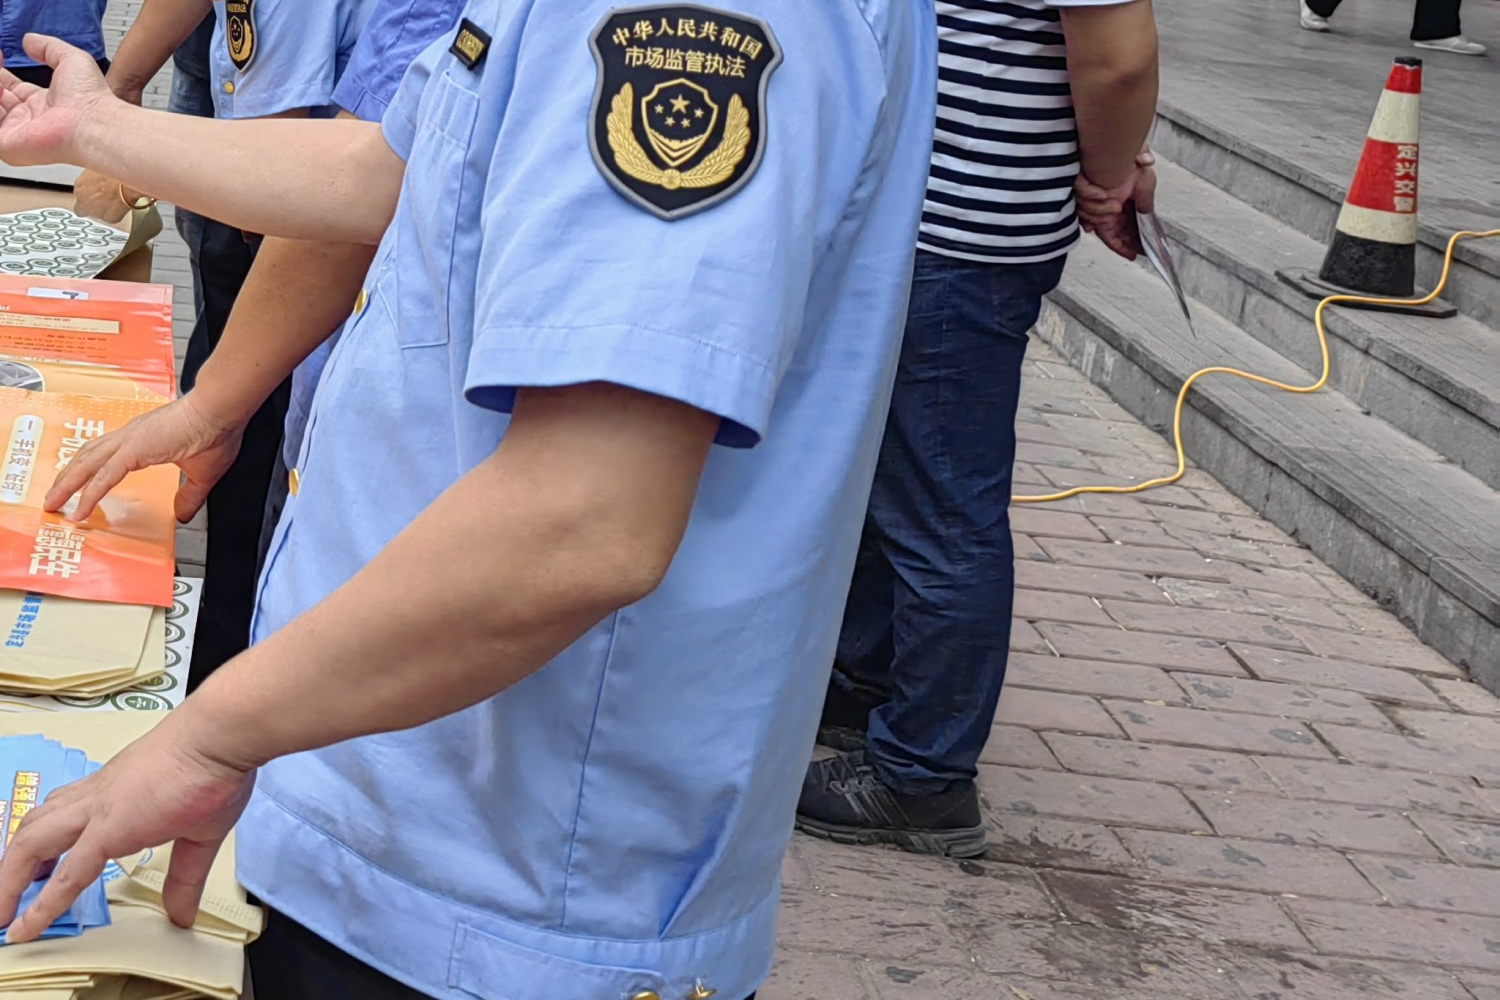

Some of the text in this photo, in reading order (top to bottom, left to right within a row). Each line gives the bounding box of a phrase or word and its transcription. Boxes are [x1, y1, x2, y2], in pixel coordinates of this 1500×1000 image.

[612, 18, 763, 60] 中华人民共和国
[625, 46, 746, 79] 市场监管执法
